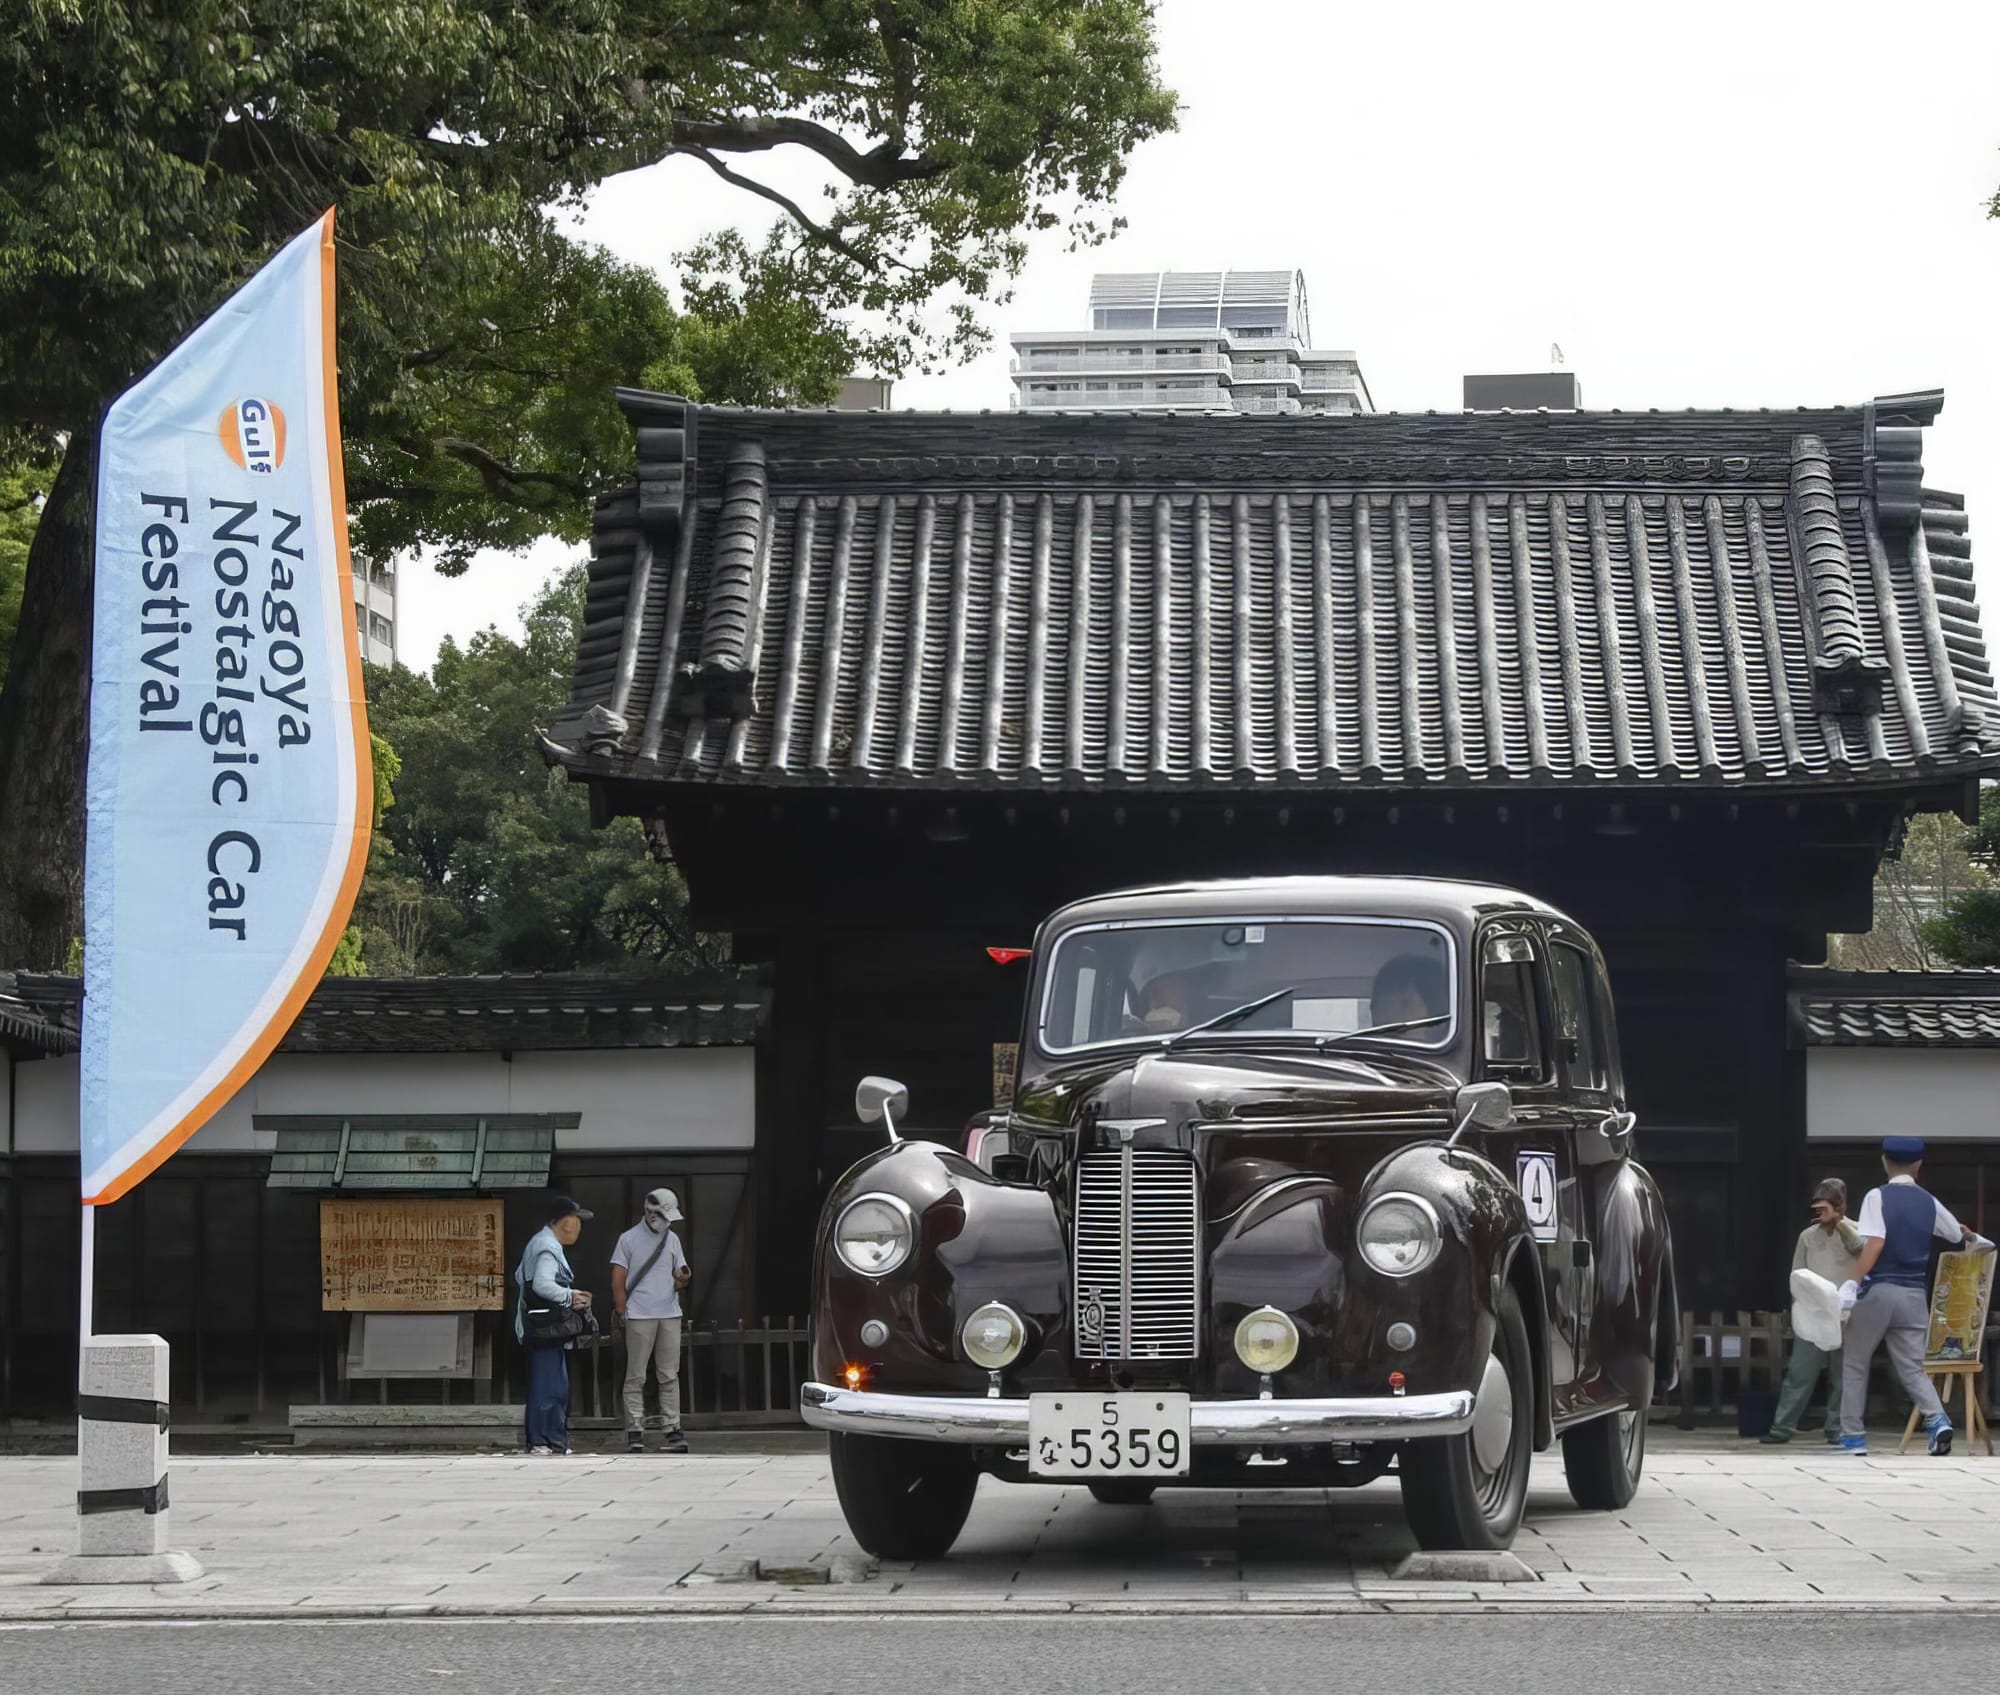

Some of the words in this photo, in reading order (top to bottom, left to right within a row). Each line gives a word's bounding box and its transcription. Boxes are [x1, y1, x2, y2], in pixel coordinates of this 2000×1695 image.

[241, 398, 272, 473] Gulf
[139, 491, 194, 732] Festival
[199, 497, 260, 806] Nostalgic
[260, 508, 311, 749] Nagoya
[207, 830, 261, 941] Car
[1531, 1166, 1543, 1214] 4
[1070, 1428, 1180, 1470] 5359
[1102, 1401, 1119, 1426] 5
